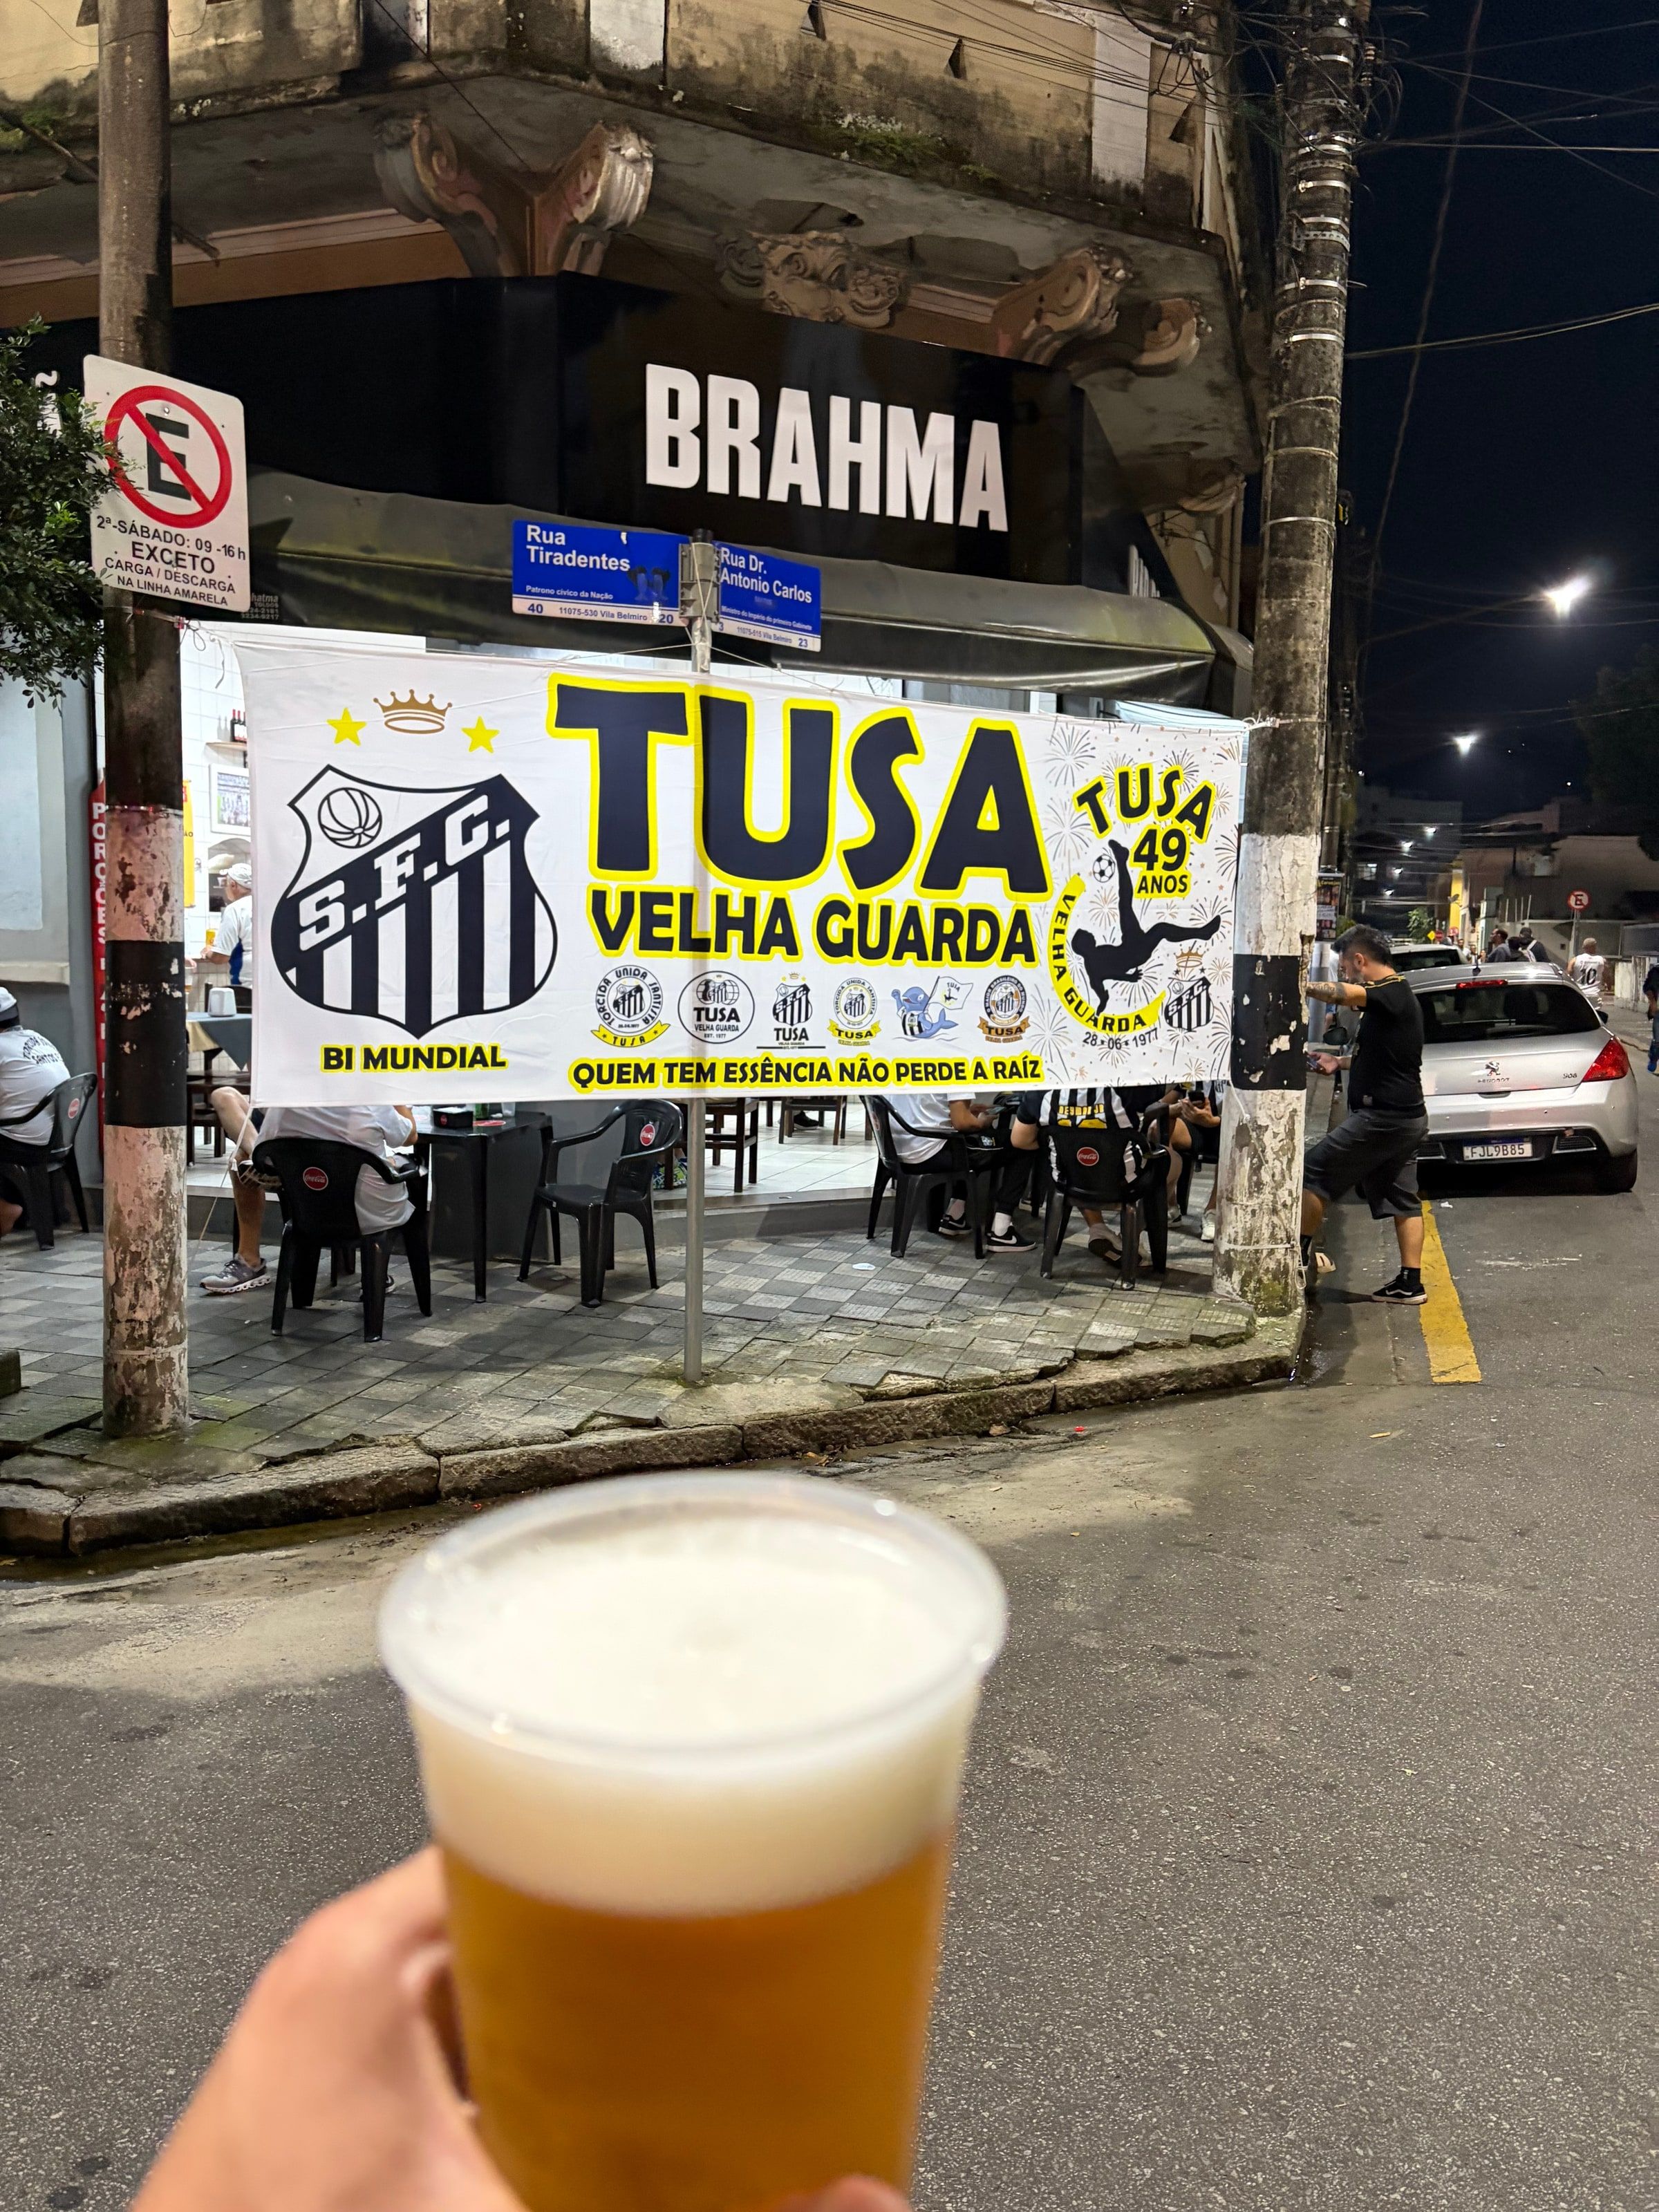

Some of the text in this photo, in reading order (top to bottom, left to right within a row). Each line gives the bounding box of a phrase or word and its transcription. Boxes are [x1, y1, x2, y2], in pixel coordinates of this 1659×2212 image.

[645, 363, 1009, 532] BRAHMA
[195, 538, 212, 553] 09
[527, 525, 565, 545] Rua
[131, 541, 216, 574] EXCETO
[527, 545, 630, 572] Tiradentes
[720, 547, 767, 574] Rua Dr.
[105, 557, 153, 578] CARGA
[165, 570, 236, 594] DESCARGA
[720, 567, 769, 594] Antonio
[773, 580, 812, 603] Carlos
[118, 575, 228, 606] NA LINHA AMARELA
[526, 585, 555, 595] Patrono
[590, 592, 613, 600] Nação
[527, 603, 543, 614] 40
[559, 607, 598, 617] 11075-530
[617, 612, 648, 621] Belmiro
[658, 614, 674, 624] 20
[798, 638, 808, 648] 23
[555, 683, 1049, 894] TUSA
[1077, 766, 1214, 839] TUSA
[1133, 828, 1188, 872] 49
[299, 794, 510, 951] S.F.C.
[1137, 874, 1189, 895] ANOS
[592, 890, 1037, 963] VELHA GUARDA
[1052, 894, 1147, 1033] VELHA GUARDA
[947, 982, 961, 992] TUSA
[1580, 968, 1597, 986] 10
[597, 968, 661, 1026] TORCIDA UNIDA SANTISTA
[693, 1007, 740, 1022] TUSA
[612, 1035, 646, 1046] TUSA
[774, 1027, 809, 1041] TUSA
[835, 1028, 873, 1039] TUSA
[986, 1026, 1023, 1035] TUSA
[323, 1045, 506, 1070] BI MUNDIAL
[573, 1055, 1041, 1087] QUEM TEM ESSÊNCIA NÃO PERDE A RAÍZ
[1470, 1143, 1525, 1158] FJL9B85
